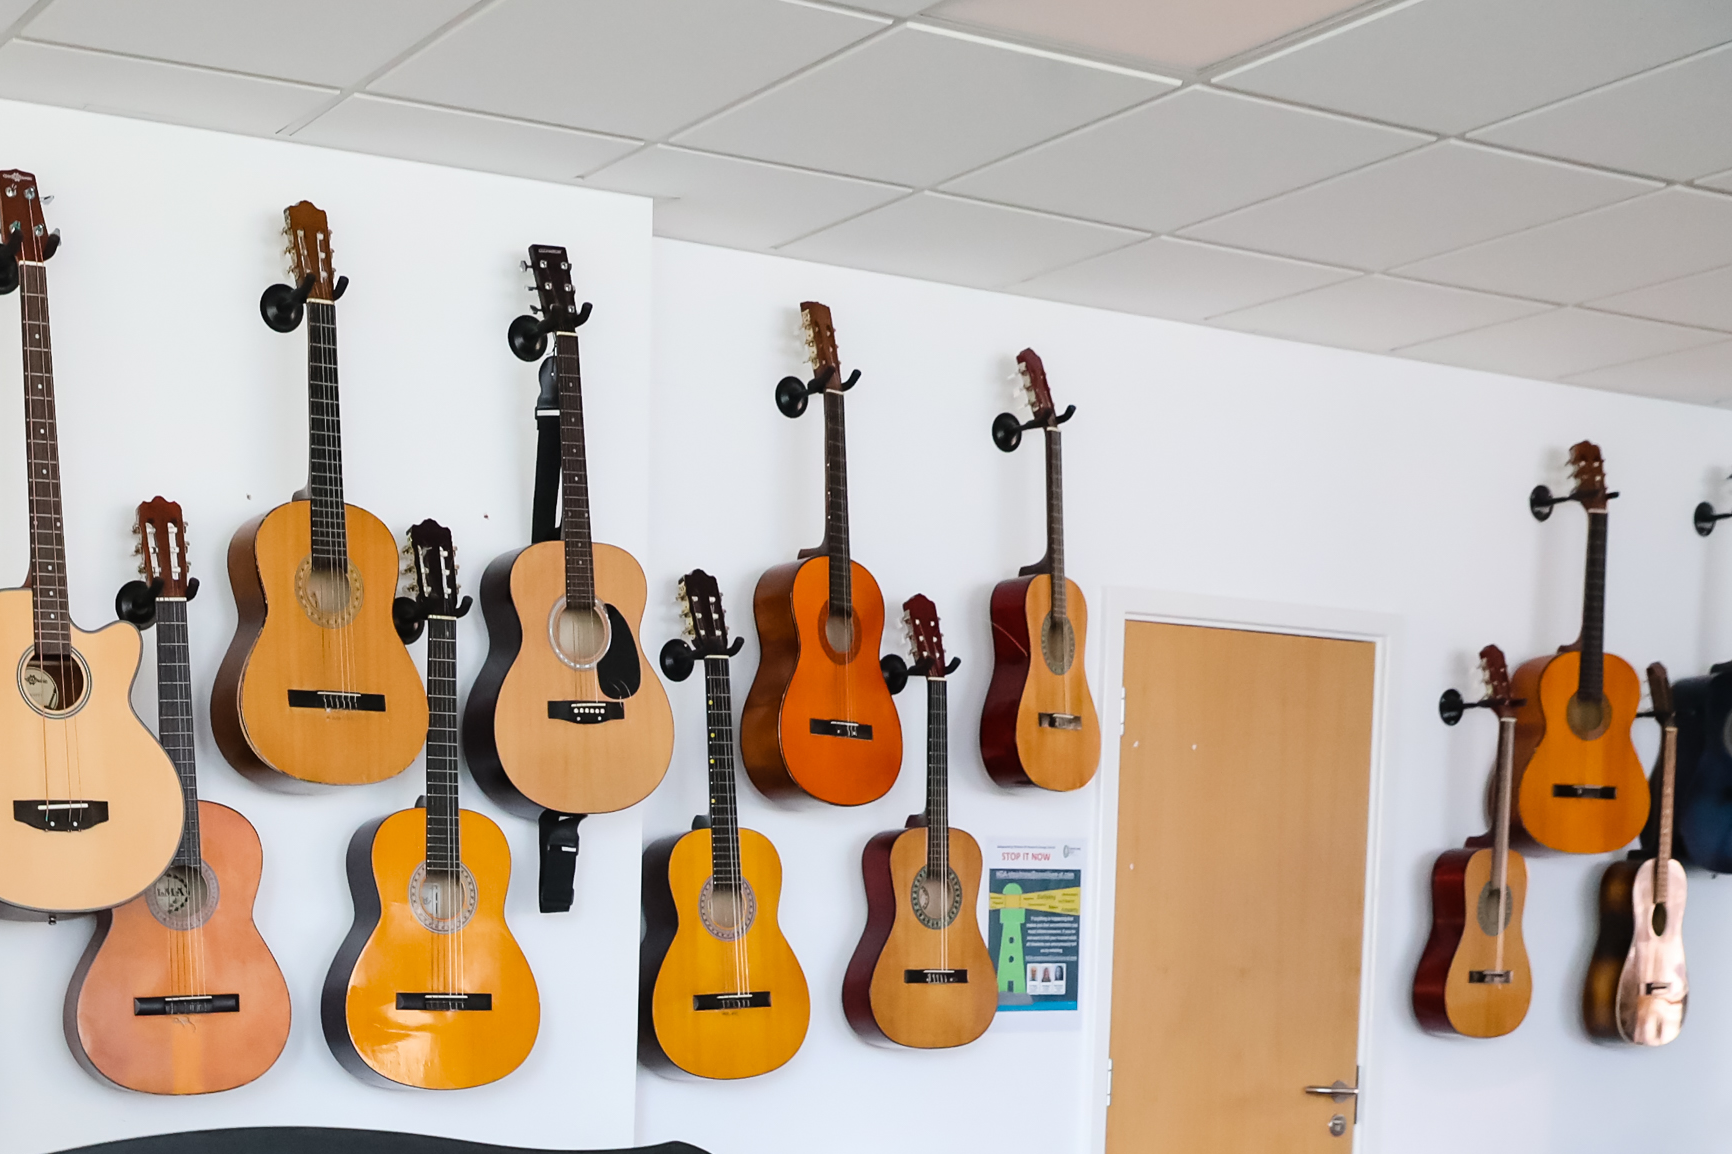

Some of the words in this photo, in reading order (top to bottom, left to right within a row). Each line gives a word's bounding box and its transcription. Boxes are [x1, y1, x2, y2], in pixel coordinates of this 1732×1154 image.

[1002, 852, 1021, 861] STOP
[1022, 852, 1030, 861] IT
[1031, 853, 1051, 861] NOW
